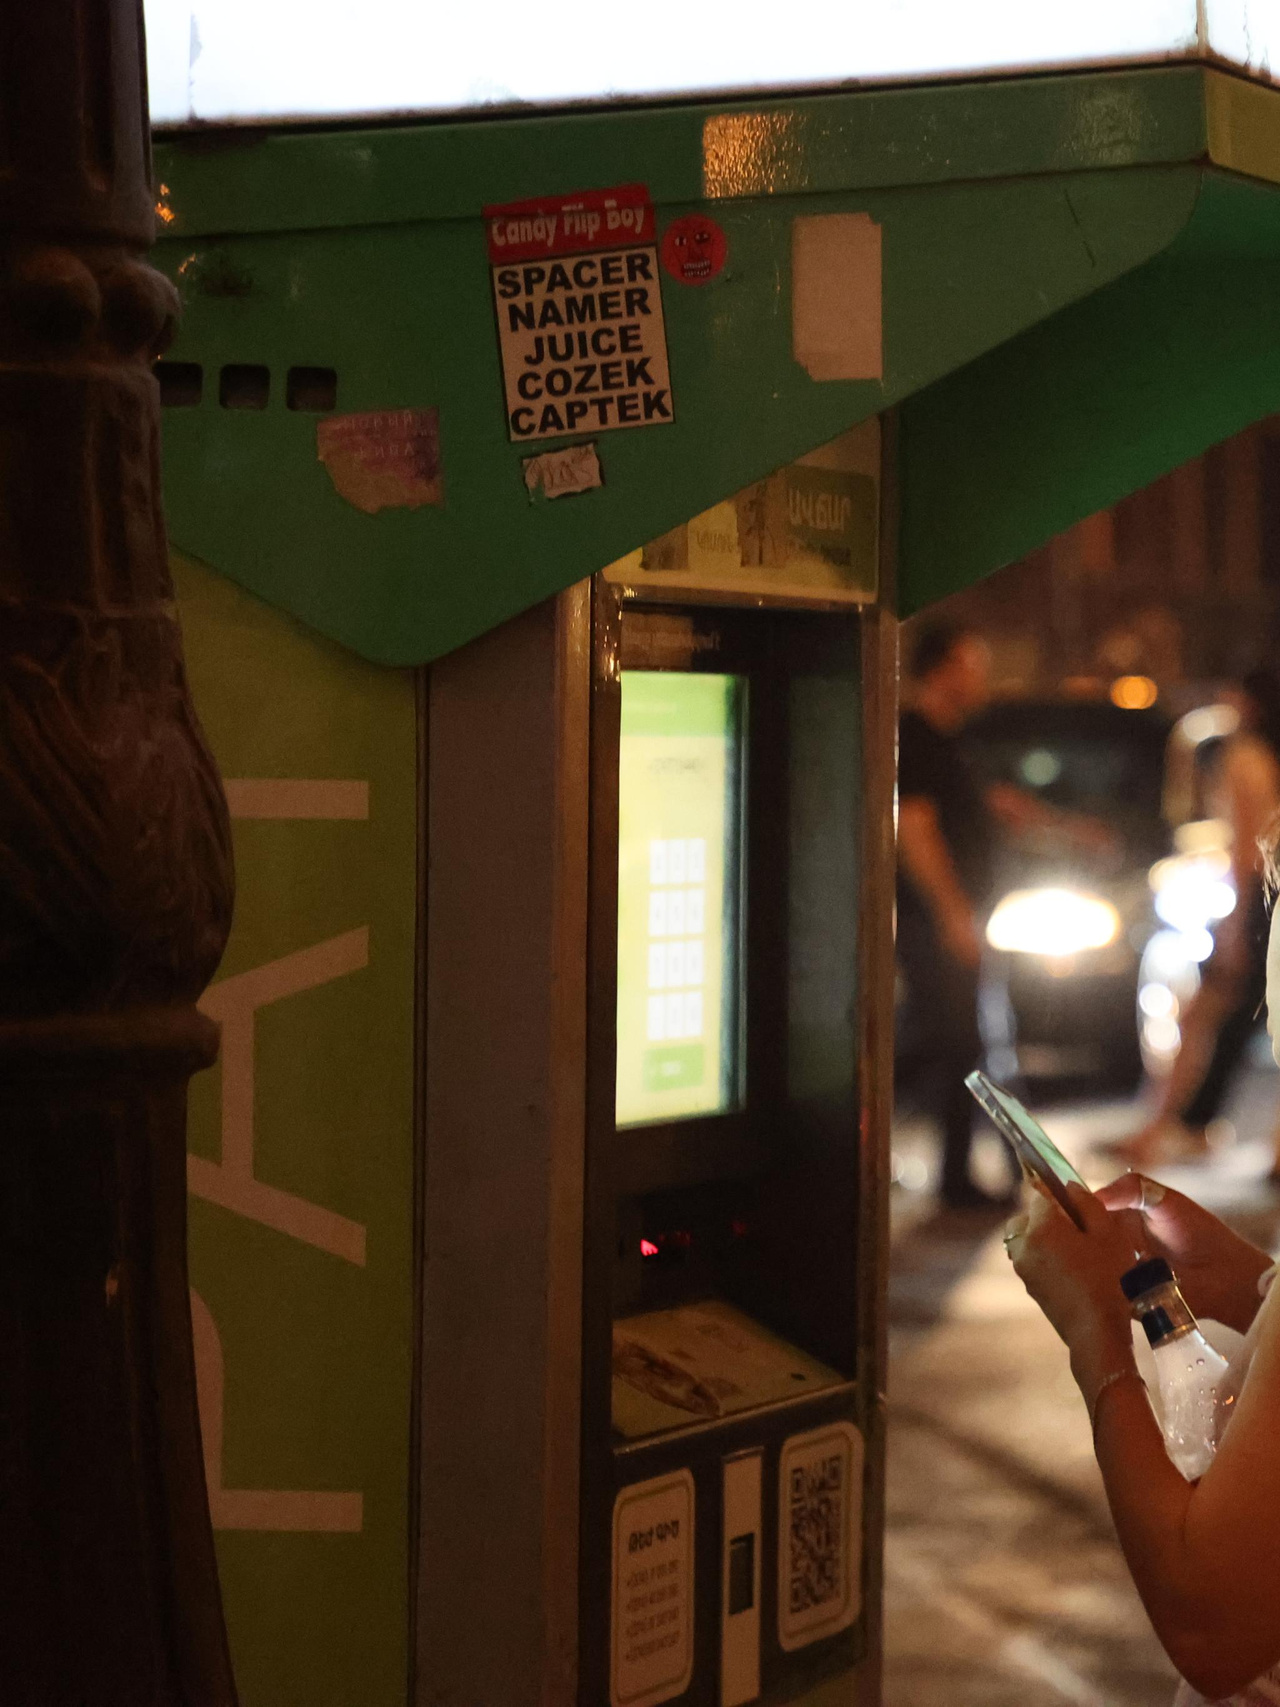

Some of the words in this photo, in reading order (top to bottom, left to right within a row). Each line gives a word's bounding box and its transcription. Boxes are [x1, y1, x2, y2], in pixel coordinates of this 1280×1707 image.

[492, 208, 557, 247] Candy
[561, 203, 600, 241] Flip
[604, 200, 646, 234] Boy
[498, 253, 654, 299] SPACER
[508, 287, 652, 332] NAMER
[524, 324, 644, 365] JUICE
[517, 357, 656, 401] COZEK
[510, 389, 672, 436] CAPTEK
